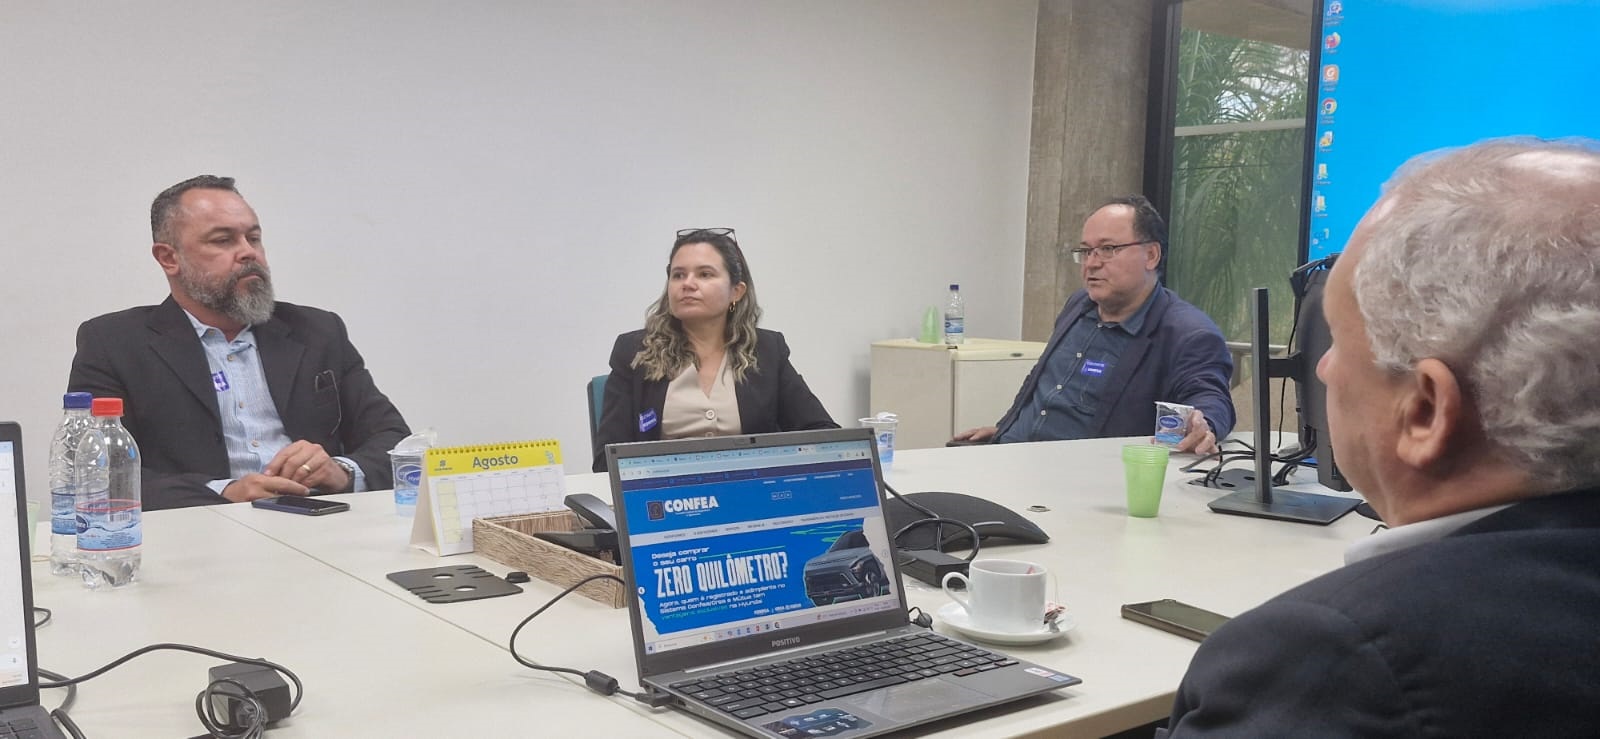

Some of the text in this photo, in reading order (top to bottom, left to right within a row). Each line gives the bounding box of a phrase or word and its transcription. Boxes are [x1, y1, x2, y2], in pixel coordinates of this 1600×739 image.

[472, 454, 518, 469] Agosto
[664, 495, 719, 513] CONFEA
[651, 547, 710, 559] Deseja comprar
[655, 552, 788, 598] ZERO QUILÔMETRO?
[772, 636, 800, 647] POSITIVO
